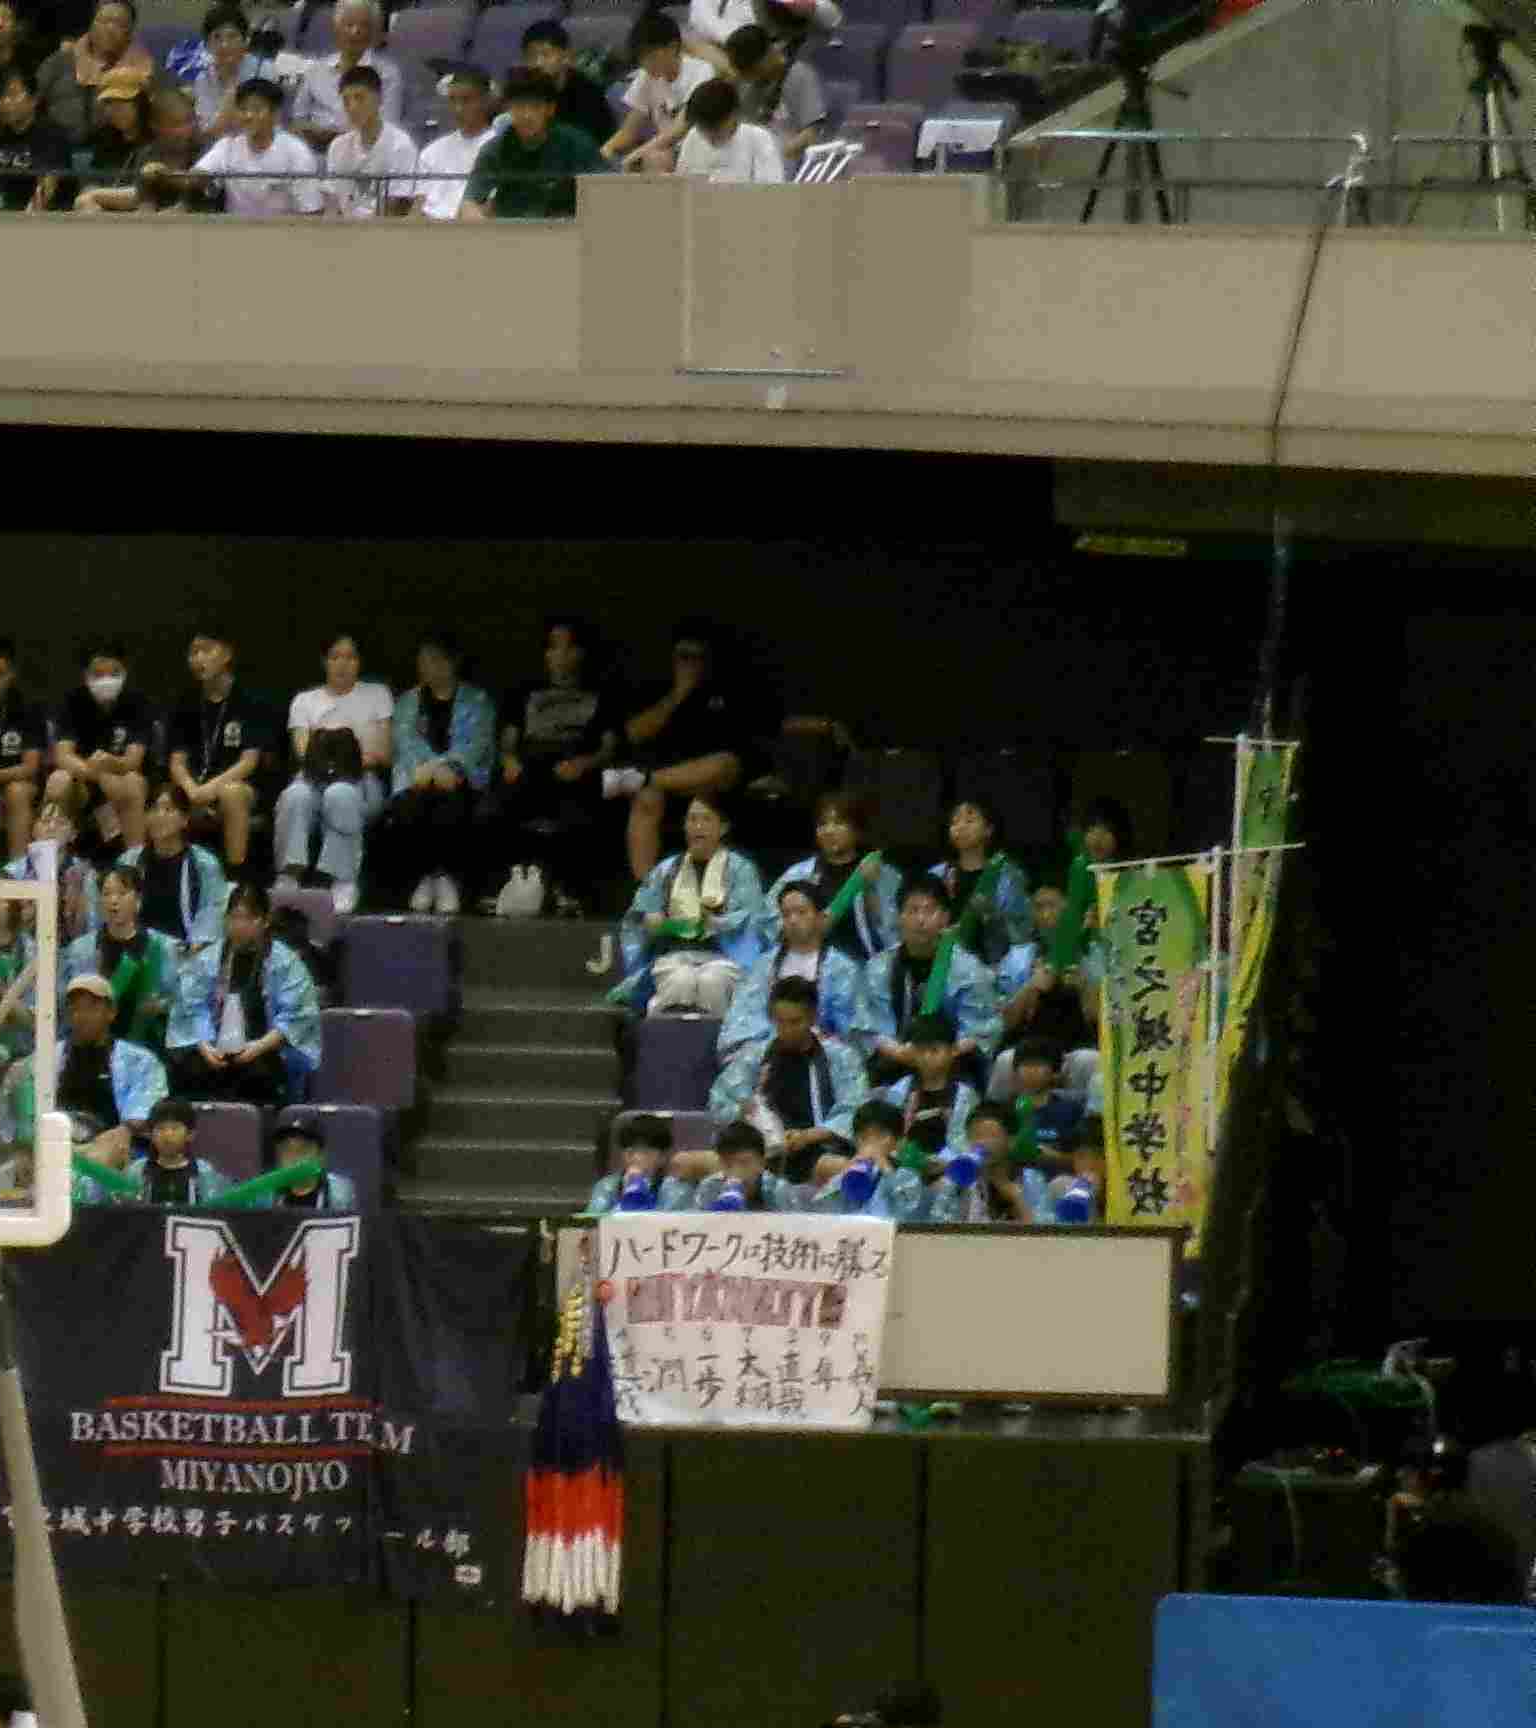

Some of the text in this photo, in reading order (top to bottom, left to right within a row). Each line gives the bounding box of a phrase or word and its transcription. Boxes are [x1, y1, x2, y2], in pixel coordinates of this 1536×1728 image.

[160, 1215, 360, 1397] M
[70, 1410, 416, 1455] BASKETBALL TEM
[159, 1459, 349, 1501] MIYANOJYO
